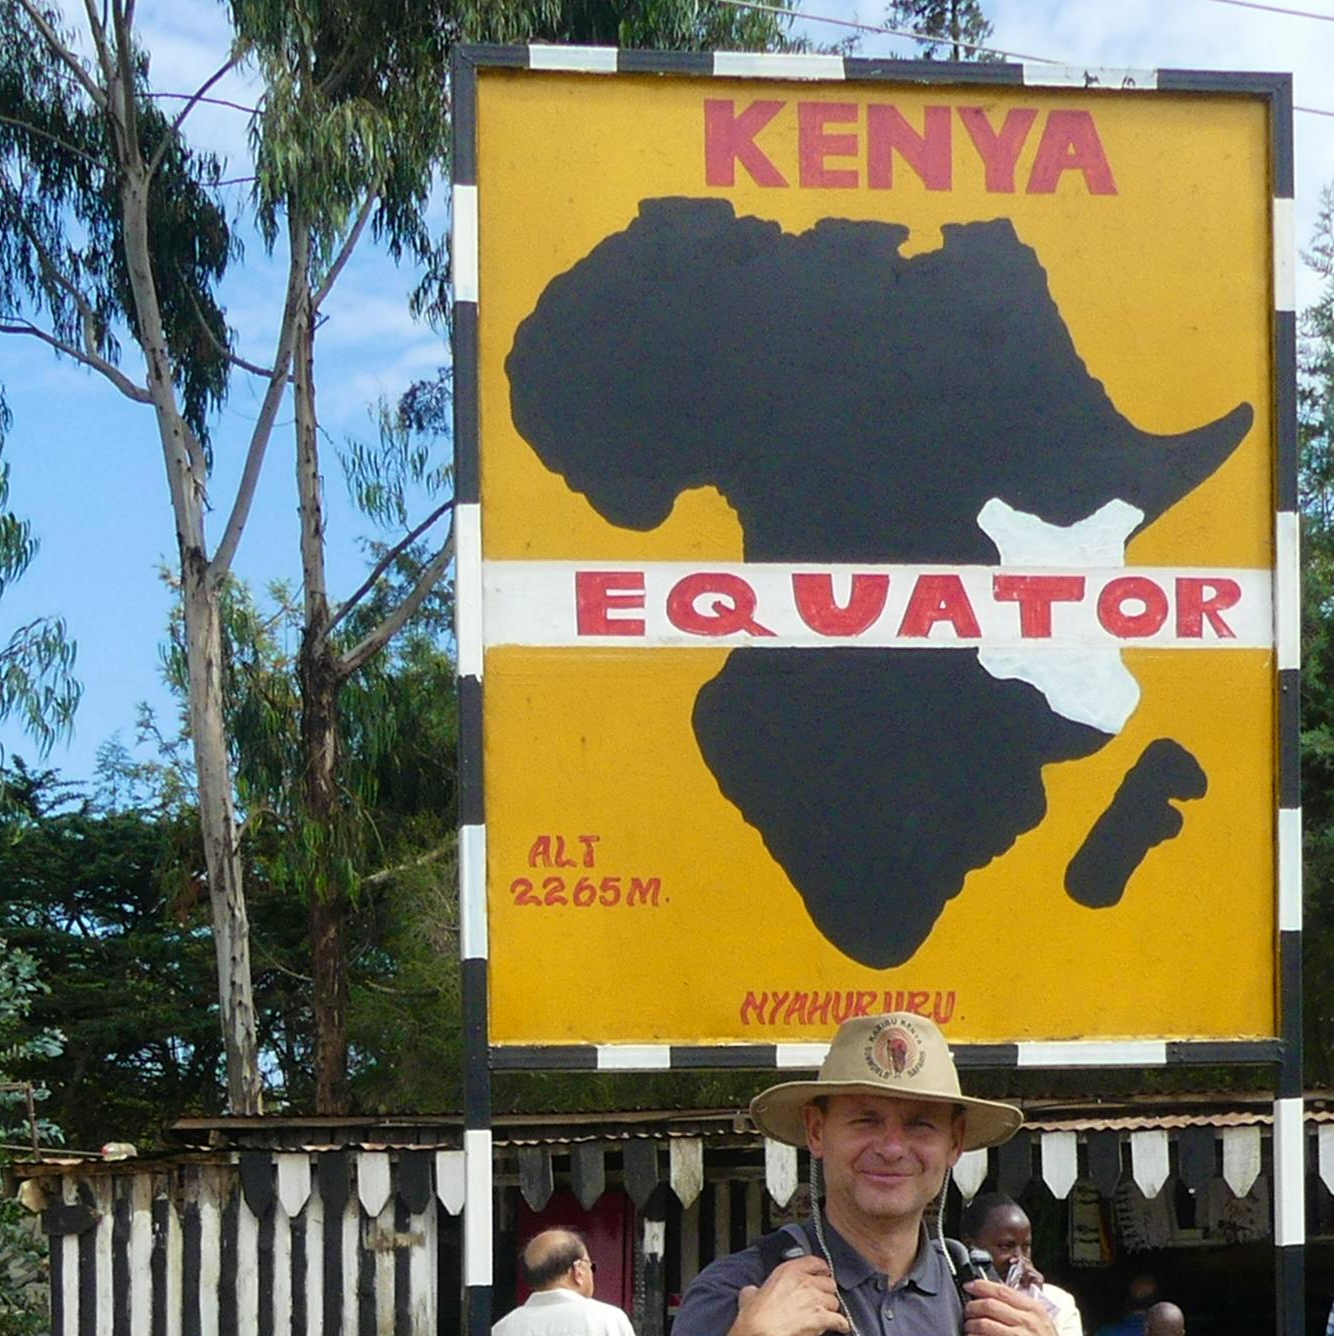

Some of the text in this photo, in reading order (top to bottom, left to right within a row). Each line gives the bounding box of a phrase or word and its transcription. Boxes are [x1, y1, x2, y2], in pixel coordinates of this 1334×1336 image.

[704, 98, 1119, 196] KENYA
[575, 571, 1242, 639] EQUATOR
[528, 835, 601, 868] ALT
[740, 991, 957, 1025] NYAHURURU
